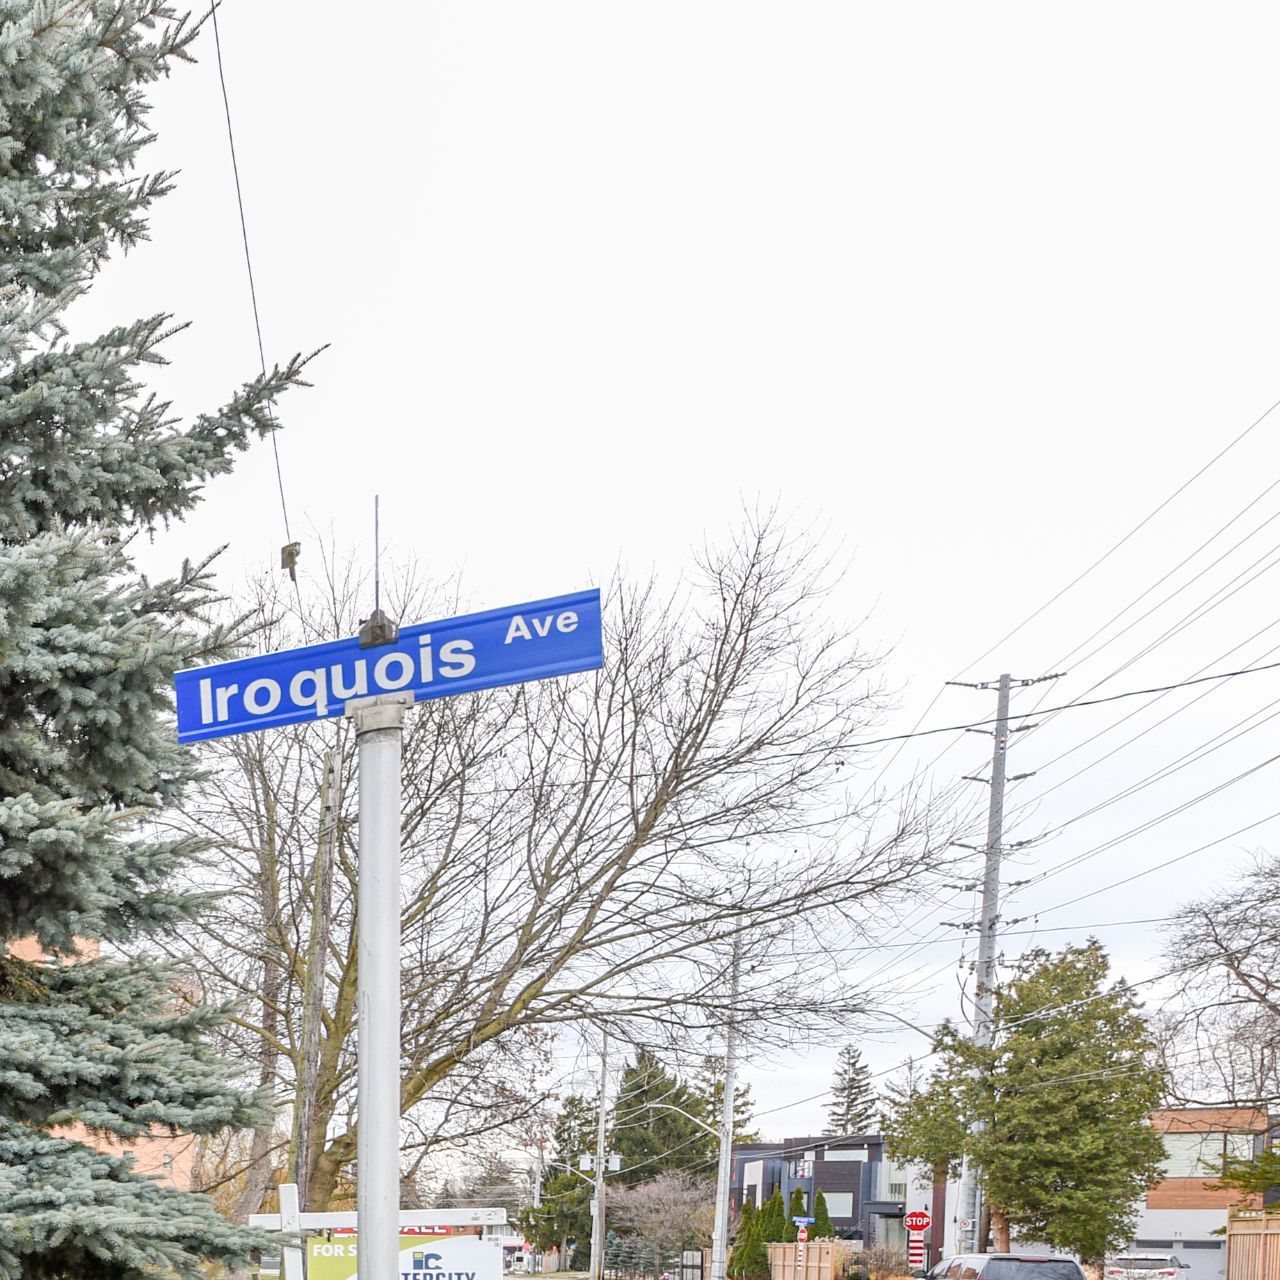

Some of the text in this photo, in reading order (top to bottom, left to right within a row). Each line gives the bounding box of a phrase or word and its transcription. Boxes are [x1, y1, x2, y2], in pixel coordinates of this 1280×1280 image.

[199, 611, 579, 725] Iroquois Ave
[905, 1217, 930, 1226] STOP
[313, 1244, 344, 1257] FOR
